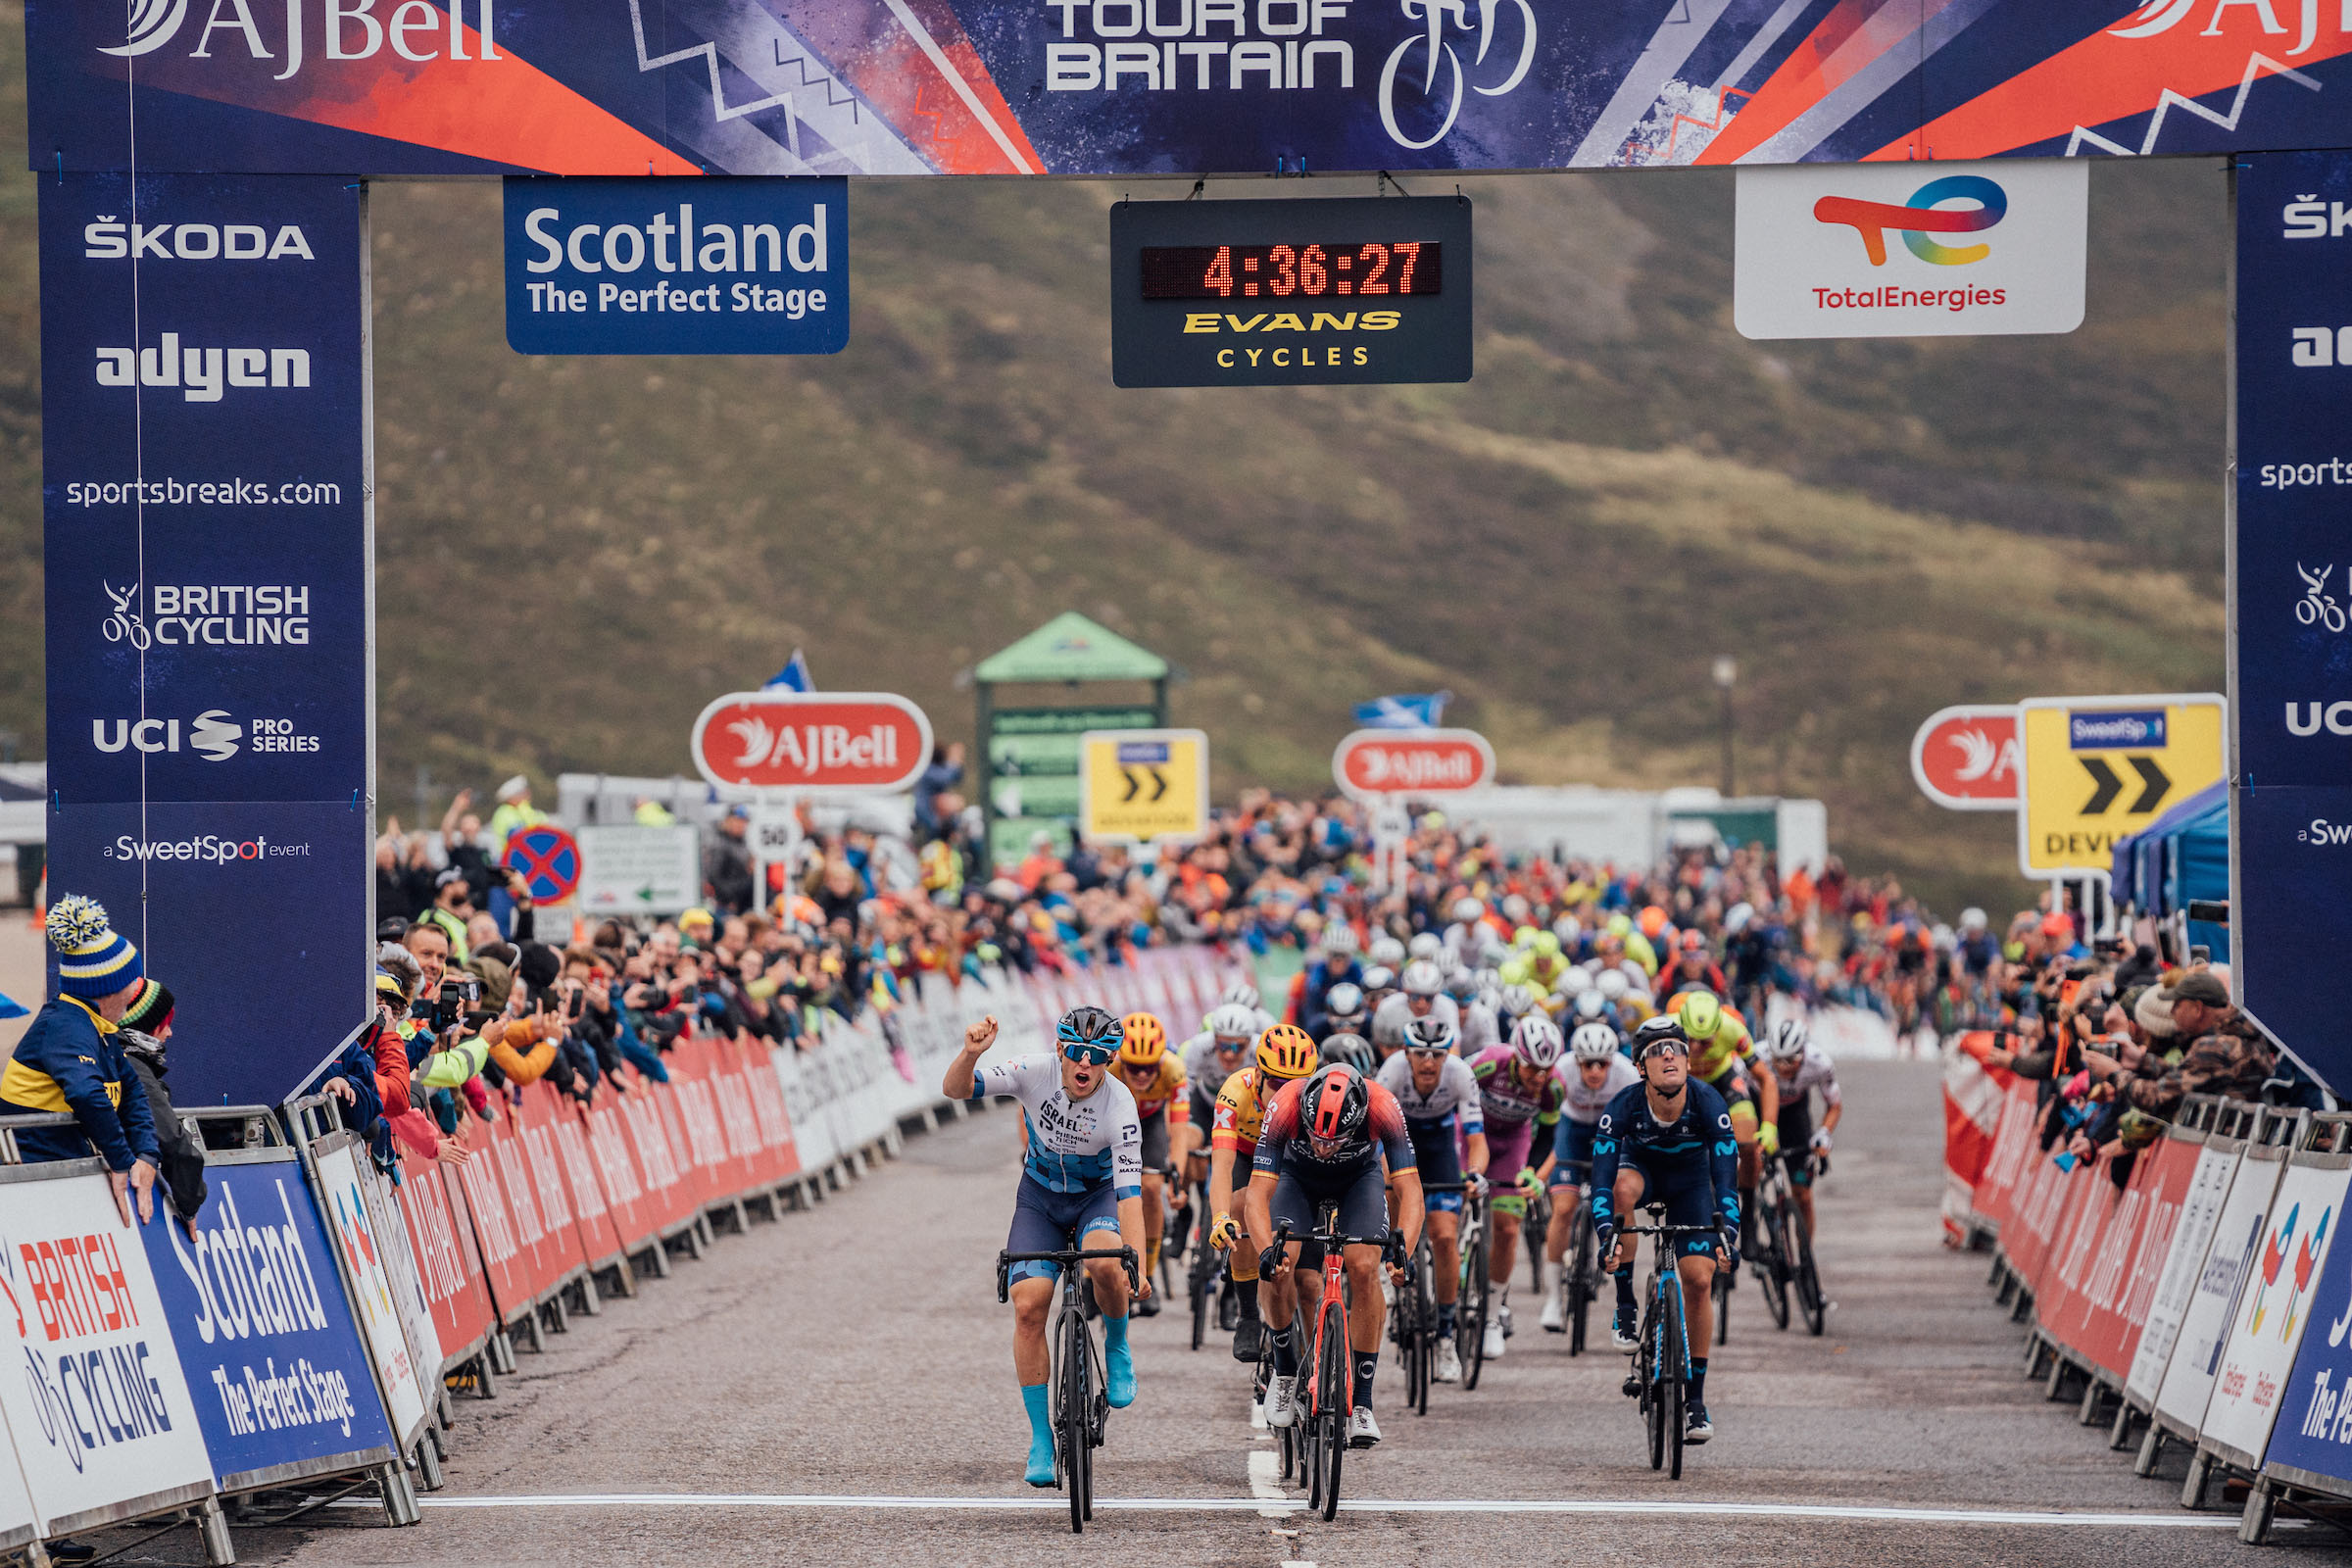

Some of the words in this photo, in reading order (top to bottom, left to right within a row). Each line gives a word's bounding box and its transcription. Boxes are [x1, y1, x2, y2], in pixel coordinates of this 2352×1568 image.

[1047, 0, 1246, 37] TOUR
[1257, 0, 1353, 35] OF
[1047, 40, 1354, 90] BRITAIN
[85, 216, 315, 260] ŠKODA
[525, 204, 828, 273] Scotland
[1204, 242, 1420, 296] 4:36:27
[526, 282, 588, 313] The
[599, 281, 721, 313] Perfect
[730, 281, 827, 320] Stage
[1812, 284, 2006, 312] TotalEnergies
[1183, 310, 1401, 334] EVANS
[96, 332, 310, 404] adyen
[1216, 347, 1368, 368] CYCLES
[67, 476, 340, 508] sportsbreaks.com
[154, 586, 309, 614] BRITISH
[154, 616, 310, 645] CYCLING
[93, 718, 180, 753] UCI
[252, 719, 294, 735] PRO
[252, 736, 320, 753] SERIES
[769, 724, 899, 776] AJBell
[104, 846, 113, 858] a
[117, 835, 267, 864] SweetSpot
[270, 842, 311, 859] event
[2046, 832, 2125, 853] DEVI
[1040, 1100, 1078, 1133] ISRAEL
[1256, 1099, 1279, 1148] INEOS
[163, 1179, 328, 1344] Scotland
[19, 1233, 140, 1342] BRITISH
[59, 1342, 172, 1448] CYCLING
[211, 1364, 256, 1436] The
[243, 1356, 313, 1431] Perfect
[298, 1357, 355, 1438] Stage
[2301, 1368, 2337, 1440] The
